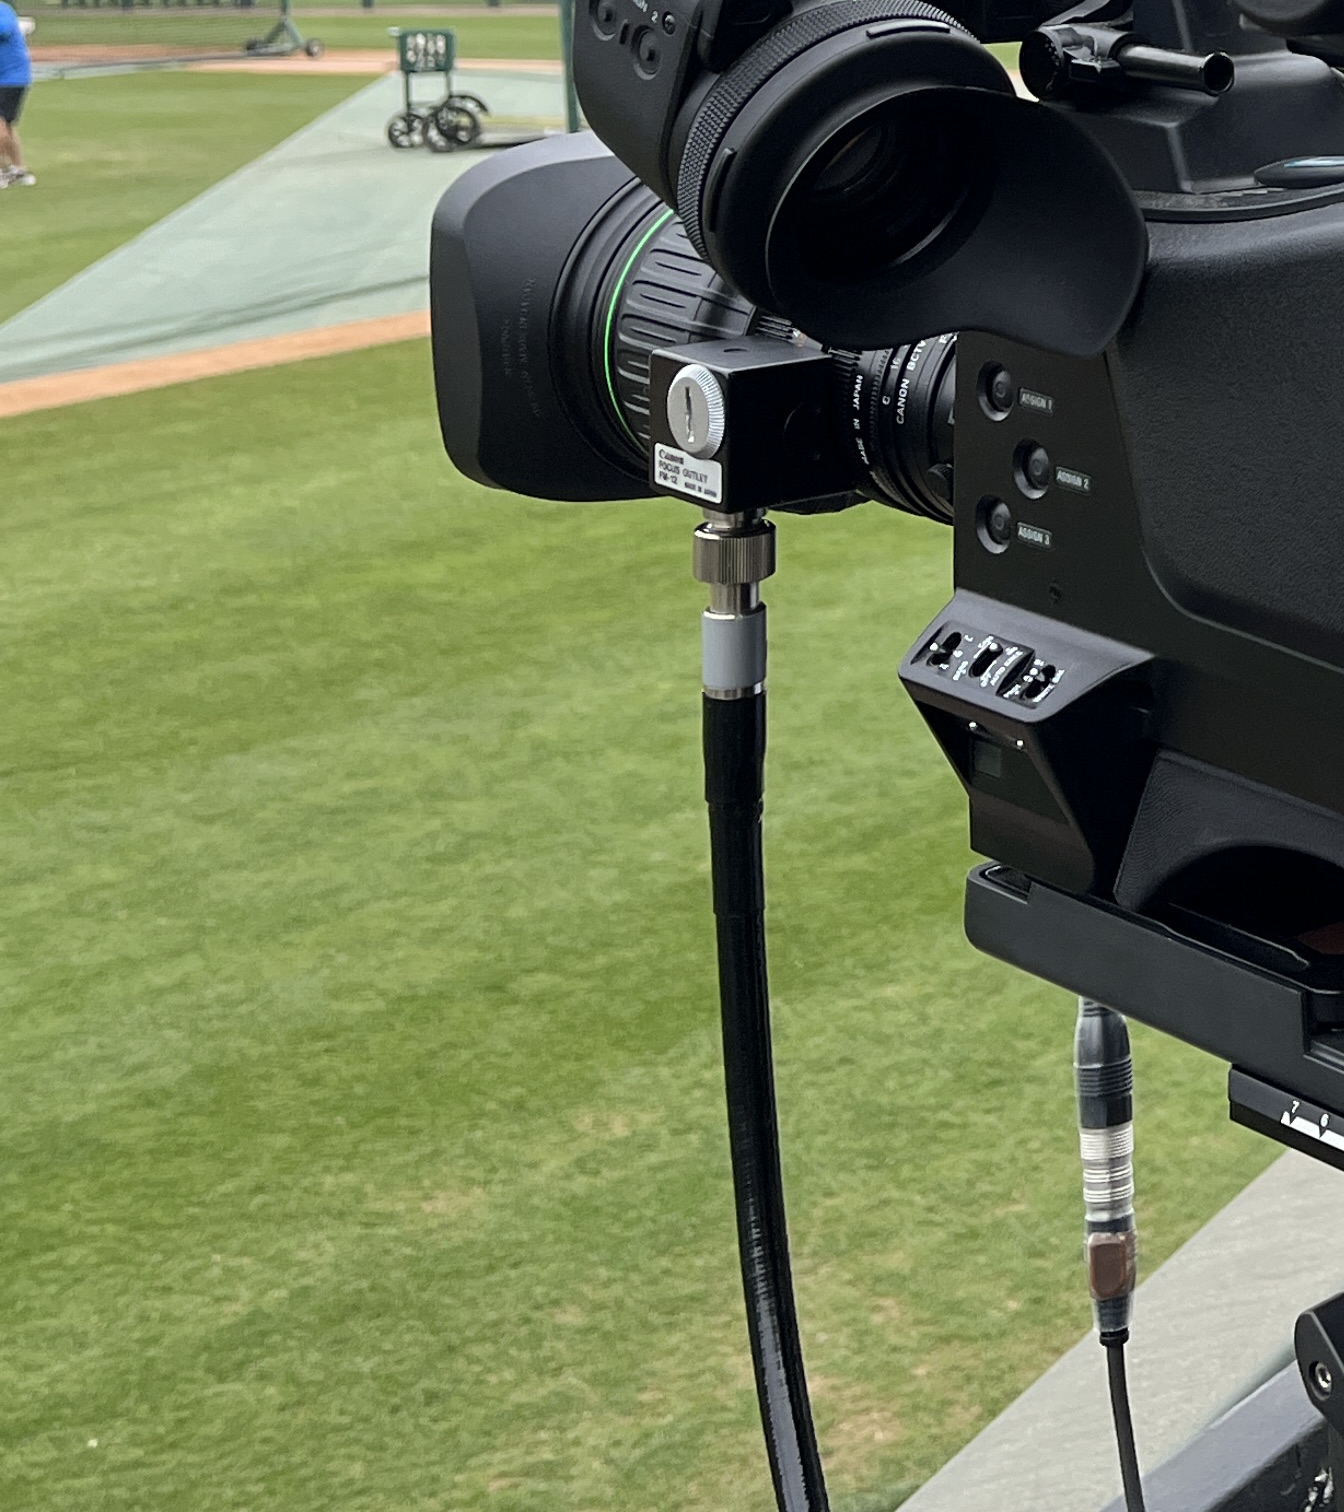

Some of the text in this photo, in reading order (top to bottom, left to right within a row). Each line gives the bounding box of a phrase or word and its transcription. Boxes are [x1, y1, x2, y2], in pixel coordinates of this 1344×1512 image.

[651, 10, 658, 23] 2
[853, 375, 864, 410] JAPAN
[1021, 392, 1047, 409] ASSIGN
[896, 378, 910, 425] CANON
[659, 448, 684, 465] Canon
[1056, 470, 1082, 487] ASSIGN
[1018, 526, 1043, 543] ASSIGN
[1291, 1100, 1299, 1114] 7
[1320, 1113, 1329, 1127] 6
